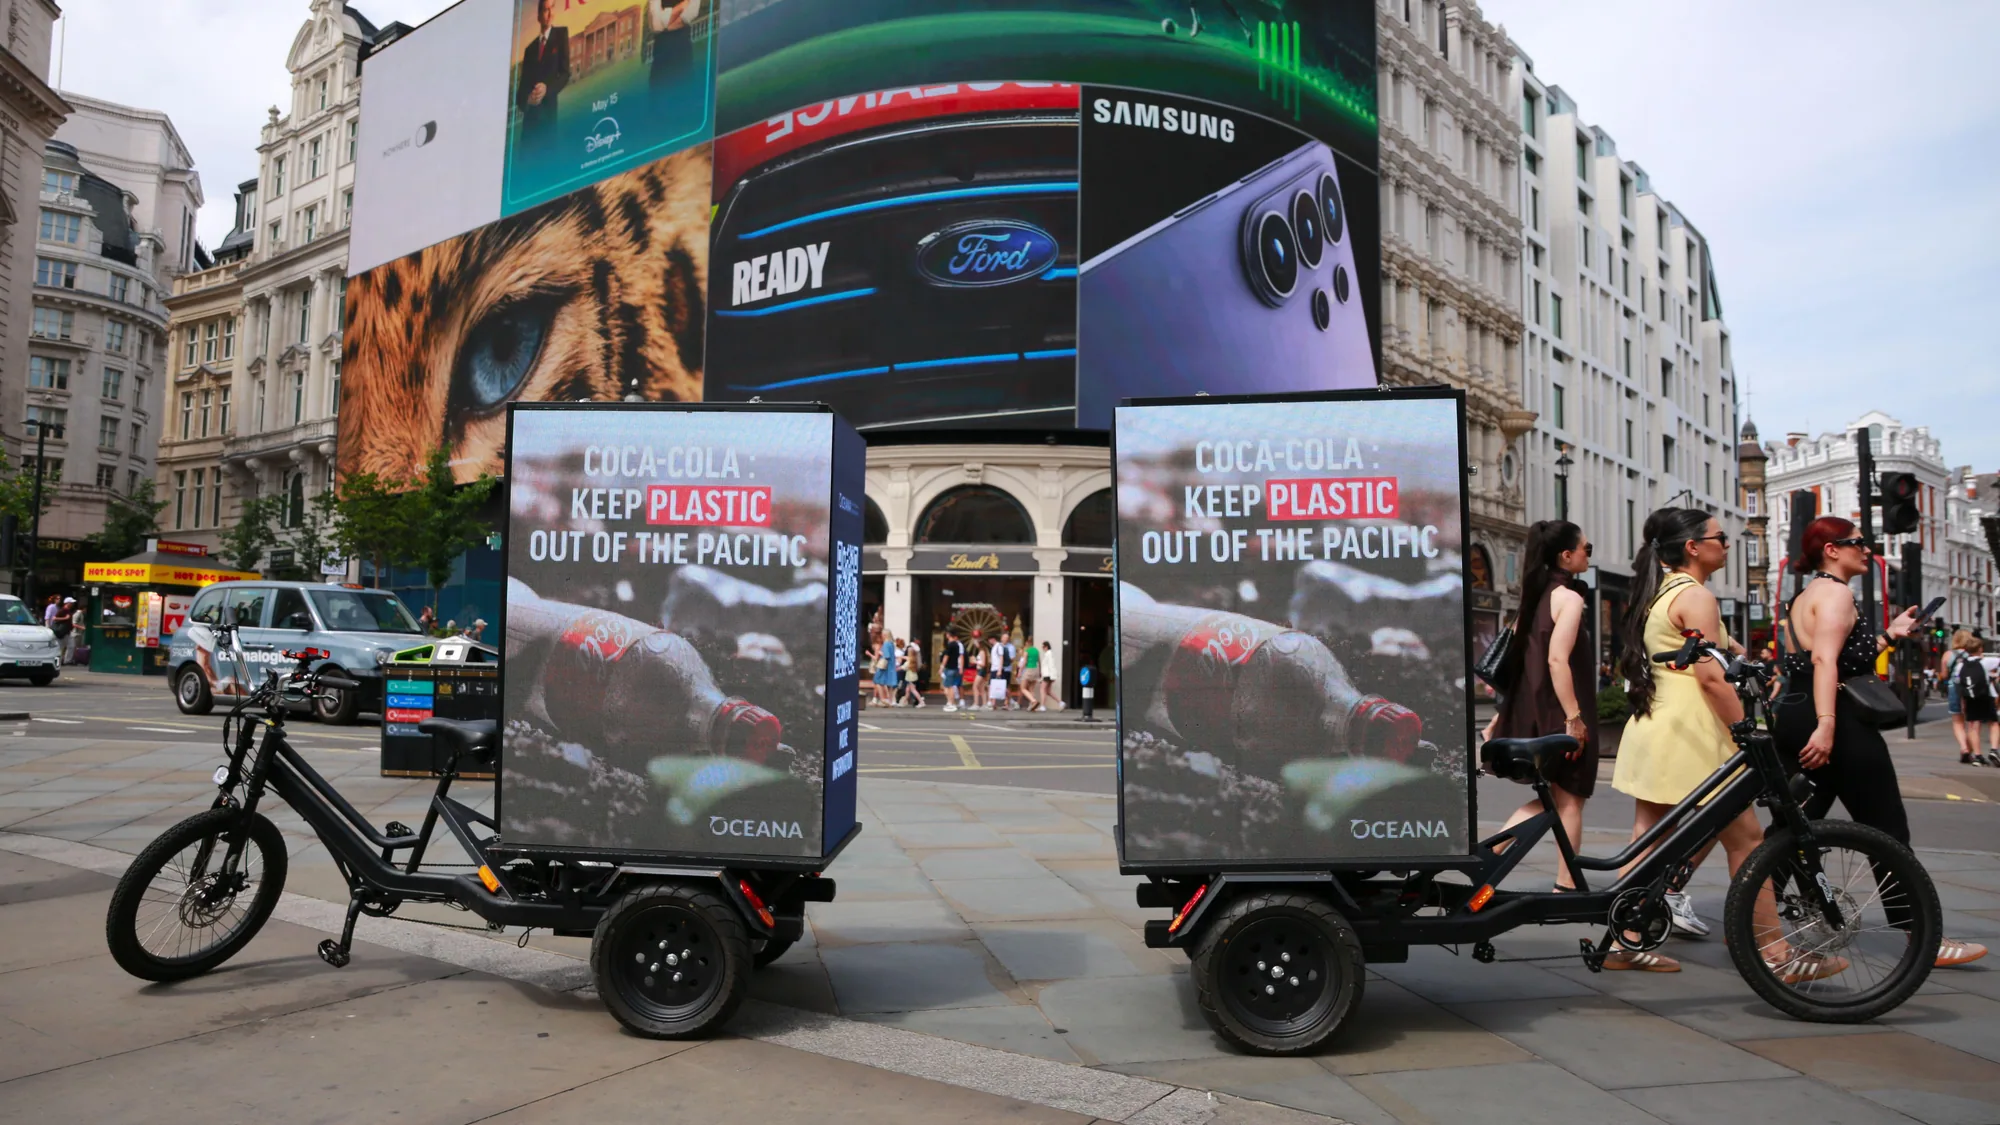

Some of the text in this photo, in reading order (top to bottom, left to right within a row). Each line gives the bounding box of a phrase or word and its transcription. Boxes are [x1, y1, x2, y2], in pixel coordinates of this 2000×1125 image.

[1093, 98, 1235, 143] SAMSUNG
[948, 233, 1032, 275] Ford
[732, 241, 830, 306] READY
[571, 488, 767, 523] KEEP PLASTIC
[1185, 481, 1394, 518] KEEP PLASTIC
[530, 531, 807, 566] OUT OF THE PACIFIC
[946, 554, 988, 570] Lindt
[1142, 530, 1202, 564] OUT
[1210, 529, 1247, 562] OF
[1256, 528, 1314, 561] THE
[1323, 525, 1439, 560] PACIFIC
[88, 568, 145, 577] HOT DOG SPOT
[174, 571, 194, 580] HOT
[196, 573, 216, 582] DOG
[709, 816, 803, 839] OCEANA
[1350, 819, 1449, 839] OCEANA
